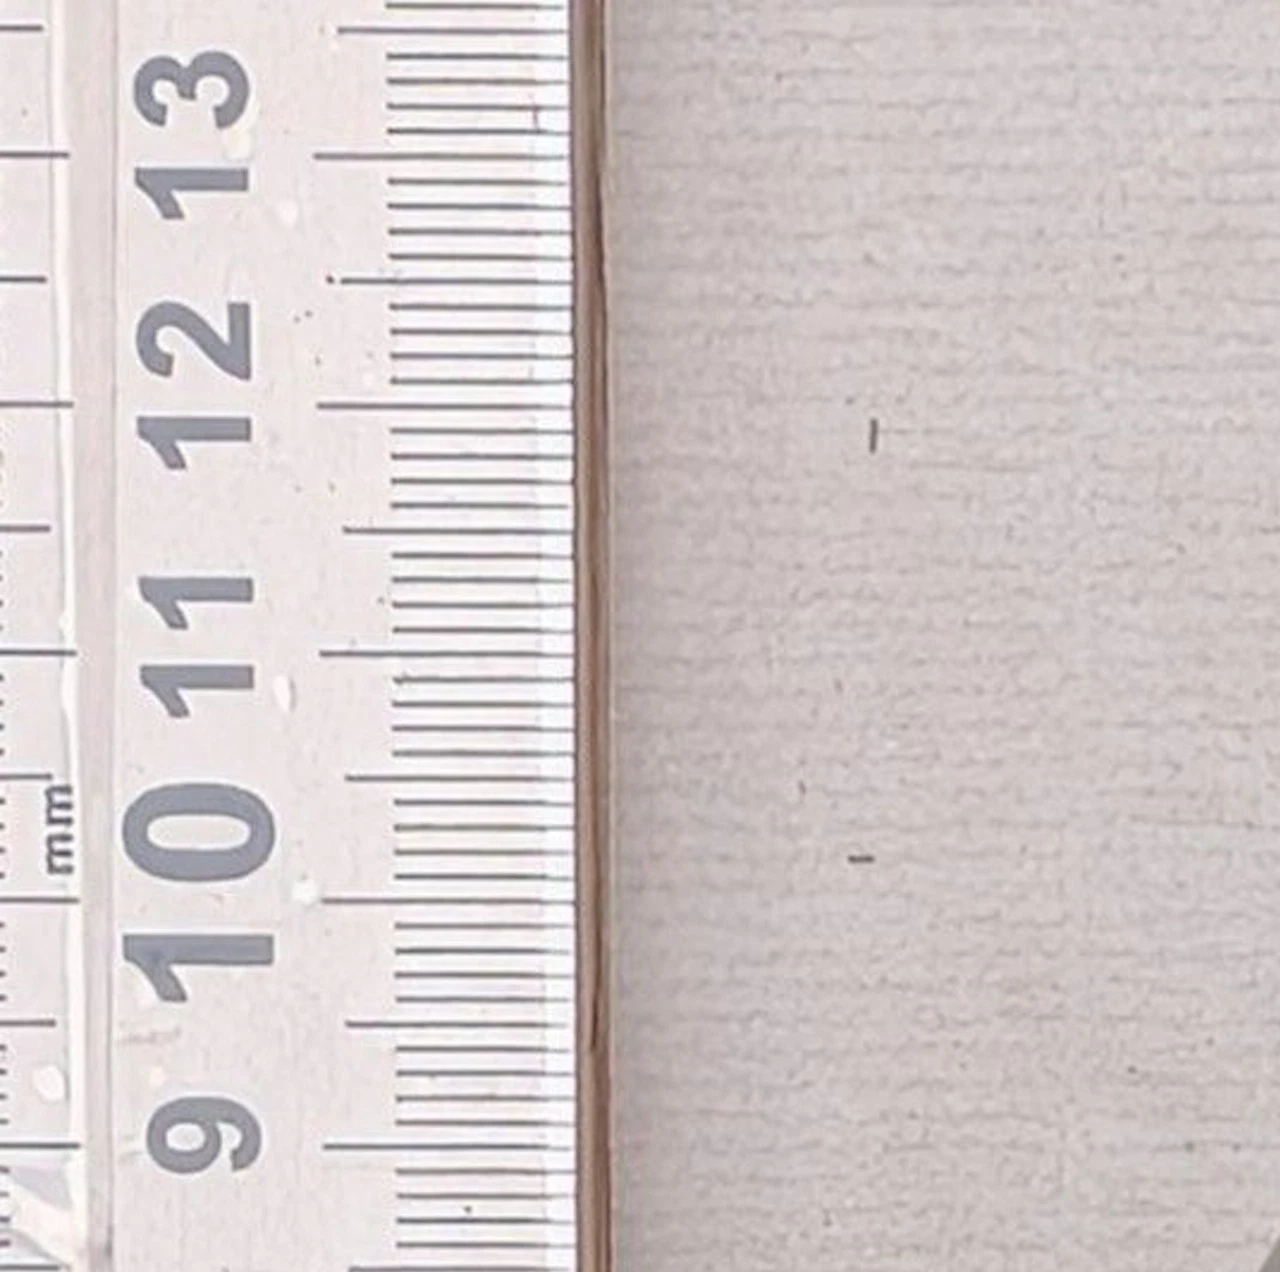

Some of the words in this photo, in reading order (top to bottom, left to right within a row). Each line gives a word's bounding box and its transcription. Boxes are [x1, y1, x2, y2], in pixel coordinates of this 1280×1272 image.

[134, 51, 249, 220] 13
[136, 302, 252, 470] 12
[138, 576, 254, 718] 11
[45, 784, 73, 874] mm
[122, 783, 275, 1003] 10
[146, 1097, 261, 1174] 9
